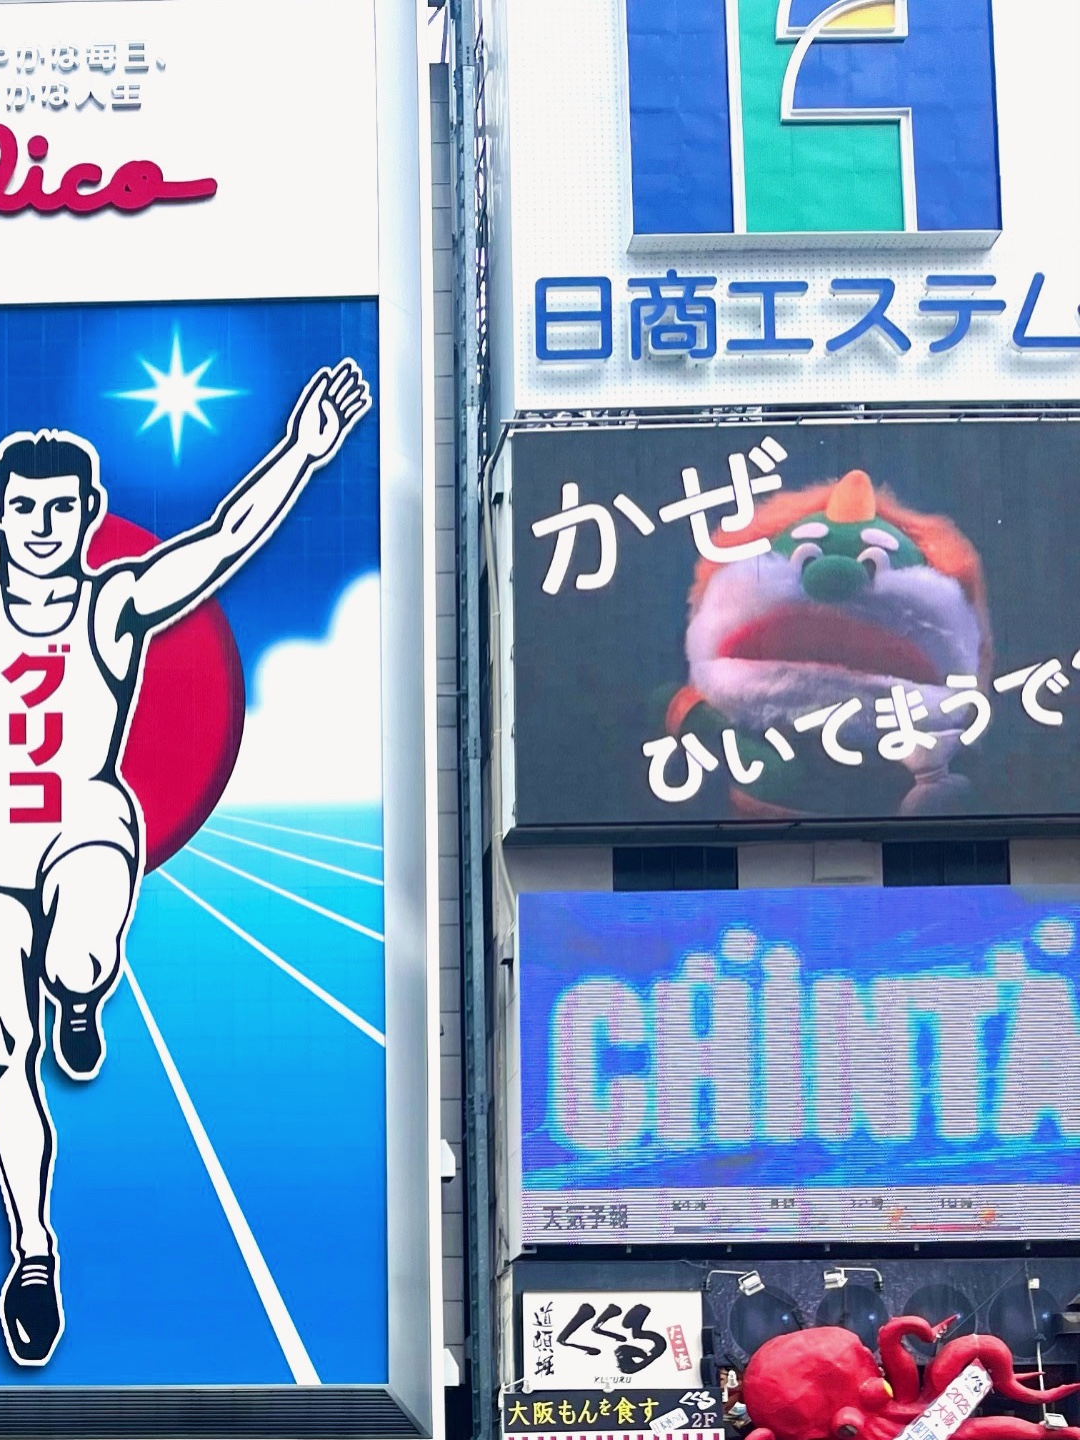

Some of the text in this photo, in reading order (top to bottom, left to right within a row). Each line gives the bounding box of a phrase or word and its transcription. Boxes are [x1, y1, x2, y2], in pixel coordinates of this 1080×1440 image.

[531, 436, 789, 596] かぜ
[1, 644, 70, 824] グリコ
[642, 650, 1080, 803] ひいてまうで
[543, 1204, 628, 1230] 天気予報
[556, 1303, 667, 1374] くくる
[508, 1396, 660, 1426] 大阪もんを食す
[932, 1403, 958, 1429] 大阪
[945, 1387, 971, 1416] 2025
[691, 1412, 717, 1428] 2F
